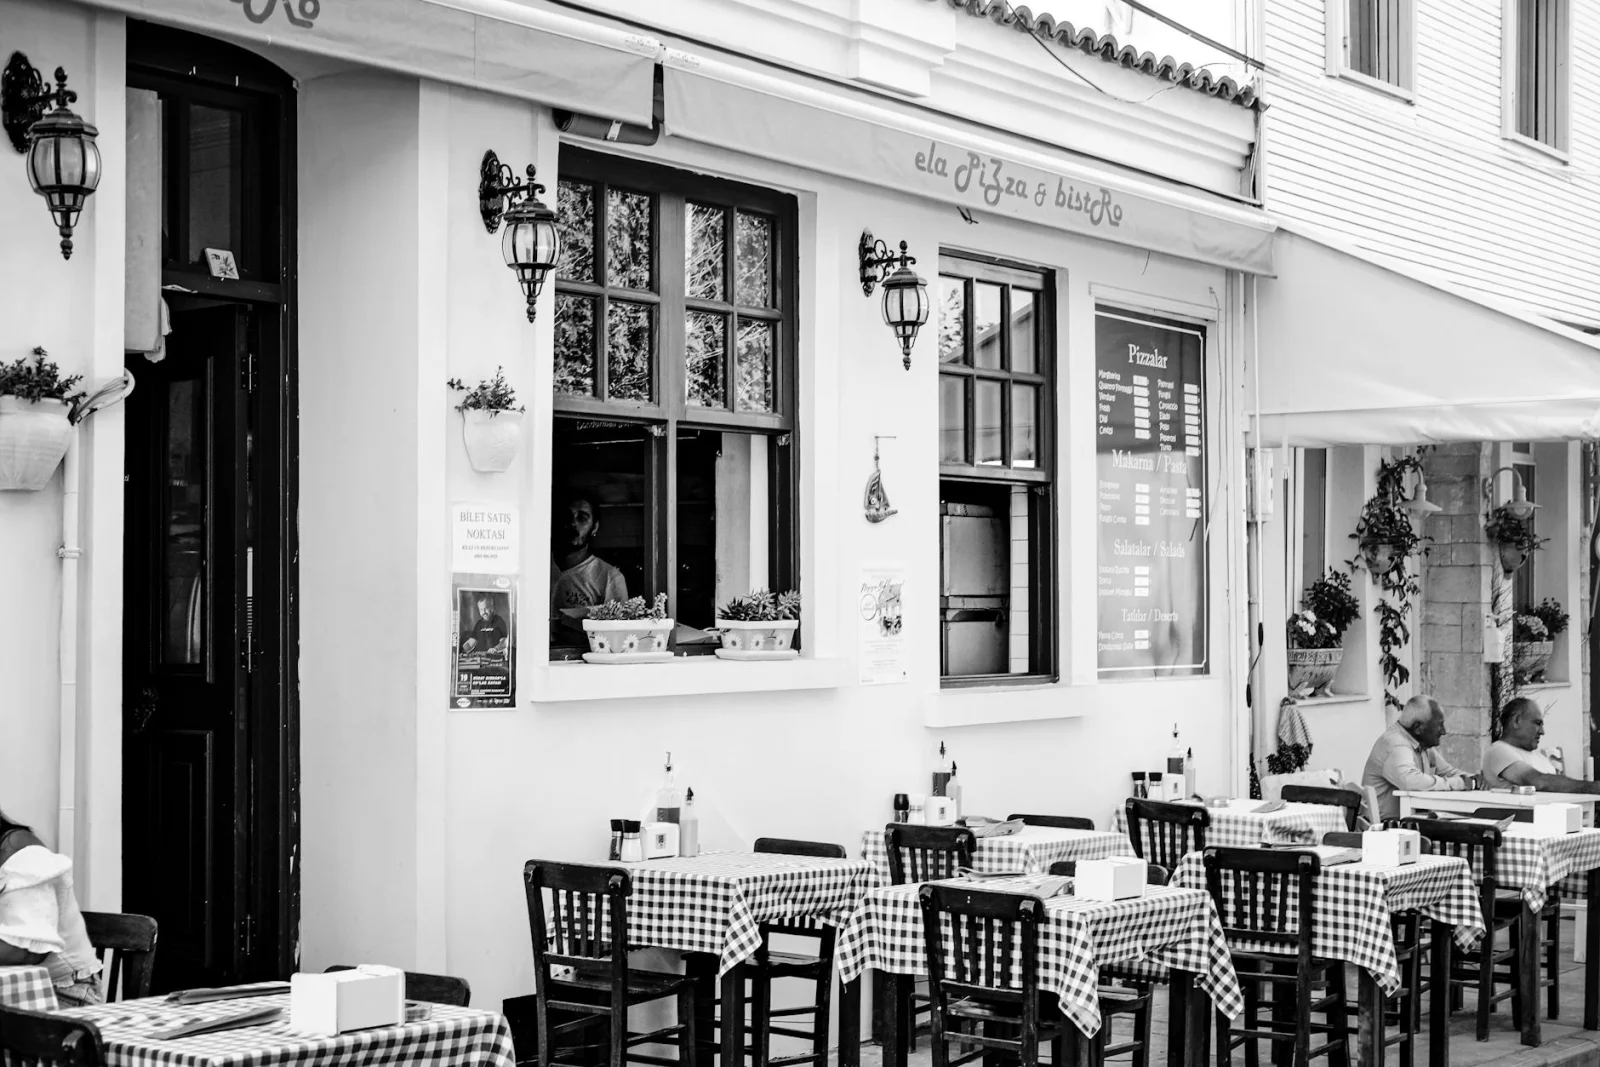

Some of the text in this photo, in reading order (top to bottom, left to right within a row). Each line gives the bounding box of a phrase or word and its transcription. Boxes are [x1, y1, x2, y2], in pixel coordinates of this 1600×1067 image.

[915, 141, 948, 178] ela
[1128, 343, 1168, 369] Pizzalar
[1112, 449, 1154, 471] Makarna
[1164, 454, 1188, 475] Pasta
[466, 528, 505, 540] NOKTASI
[1114, 538, 1151, 557] Salatalar
[1160, 540, 1186, 558] Salads
